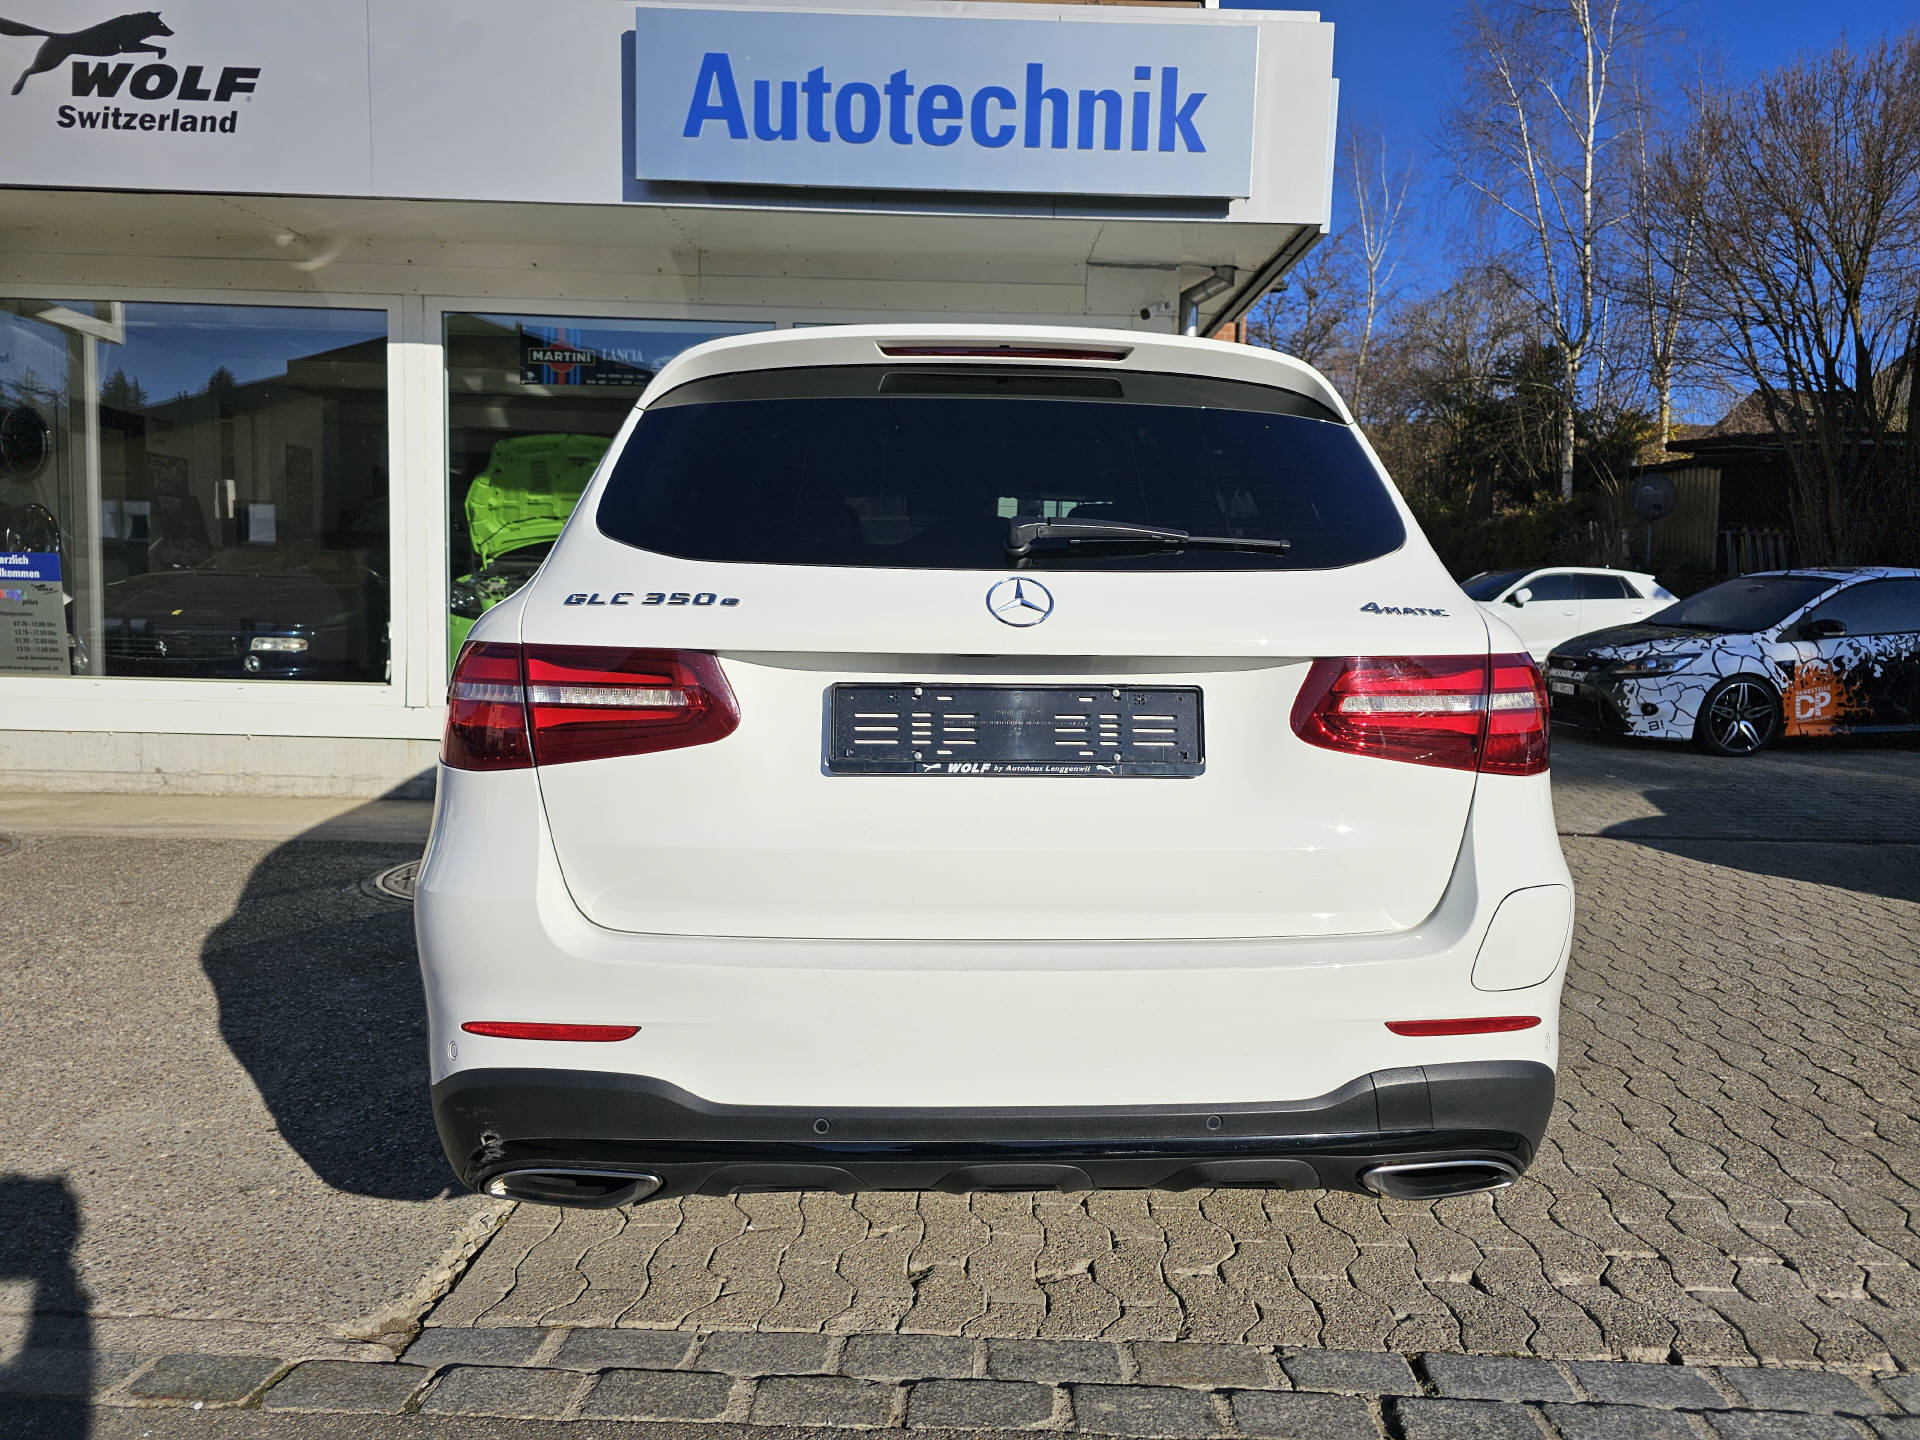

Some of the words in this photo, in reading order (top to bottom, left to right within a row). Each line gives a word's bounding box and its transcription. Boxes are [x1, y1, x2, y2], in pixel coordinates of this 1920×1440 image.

[71, 61, 262, 103] WOLF
[682, 51, 1208, 154] Autotechnik
[56, 104, 238, 134] Switzerland
[532, 350, 592, 363] MARTINI
[601, 348, 644, 362] LANCIA
[563, 592, 634, 606] GLC
[1359, 602, 1450, 617] 4MATIC
[1795, 692, 1831, 719] CP
[947, 763, 991, 773] WOLF
[994, 764, 1004, 773] by
[1005, 764, 1043, 772] Autohaus
[1045, 764, 1090, 774] Lenggenwil
